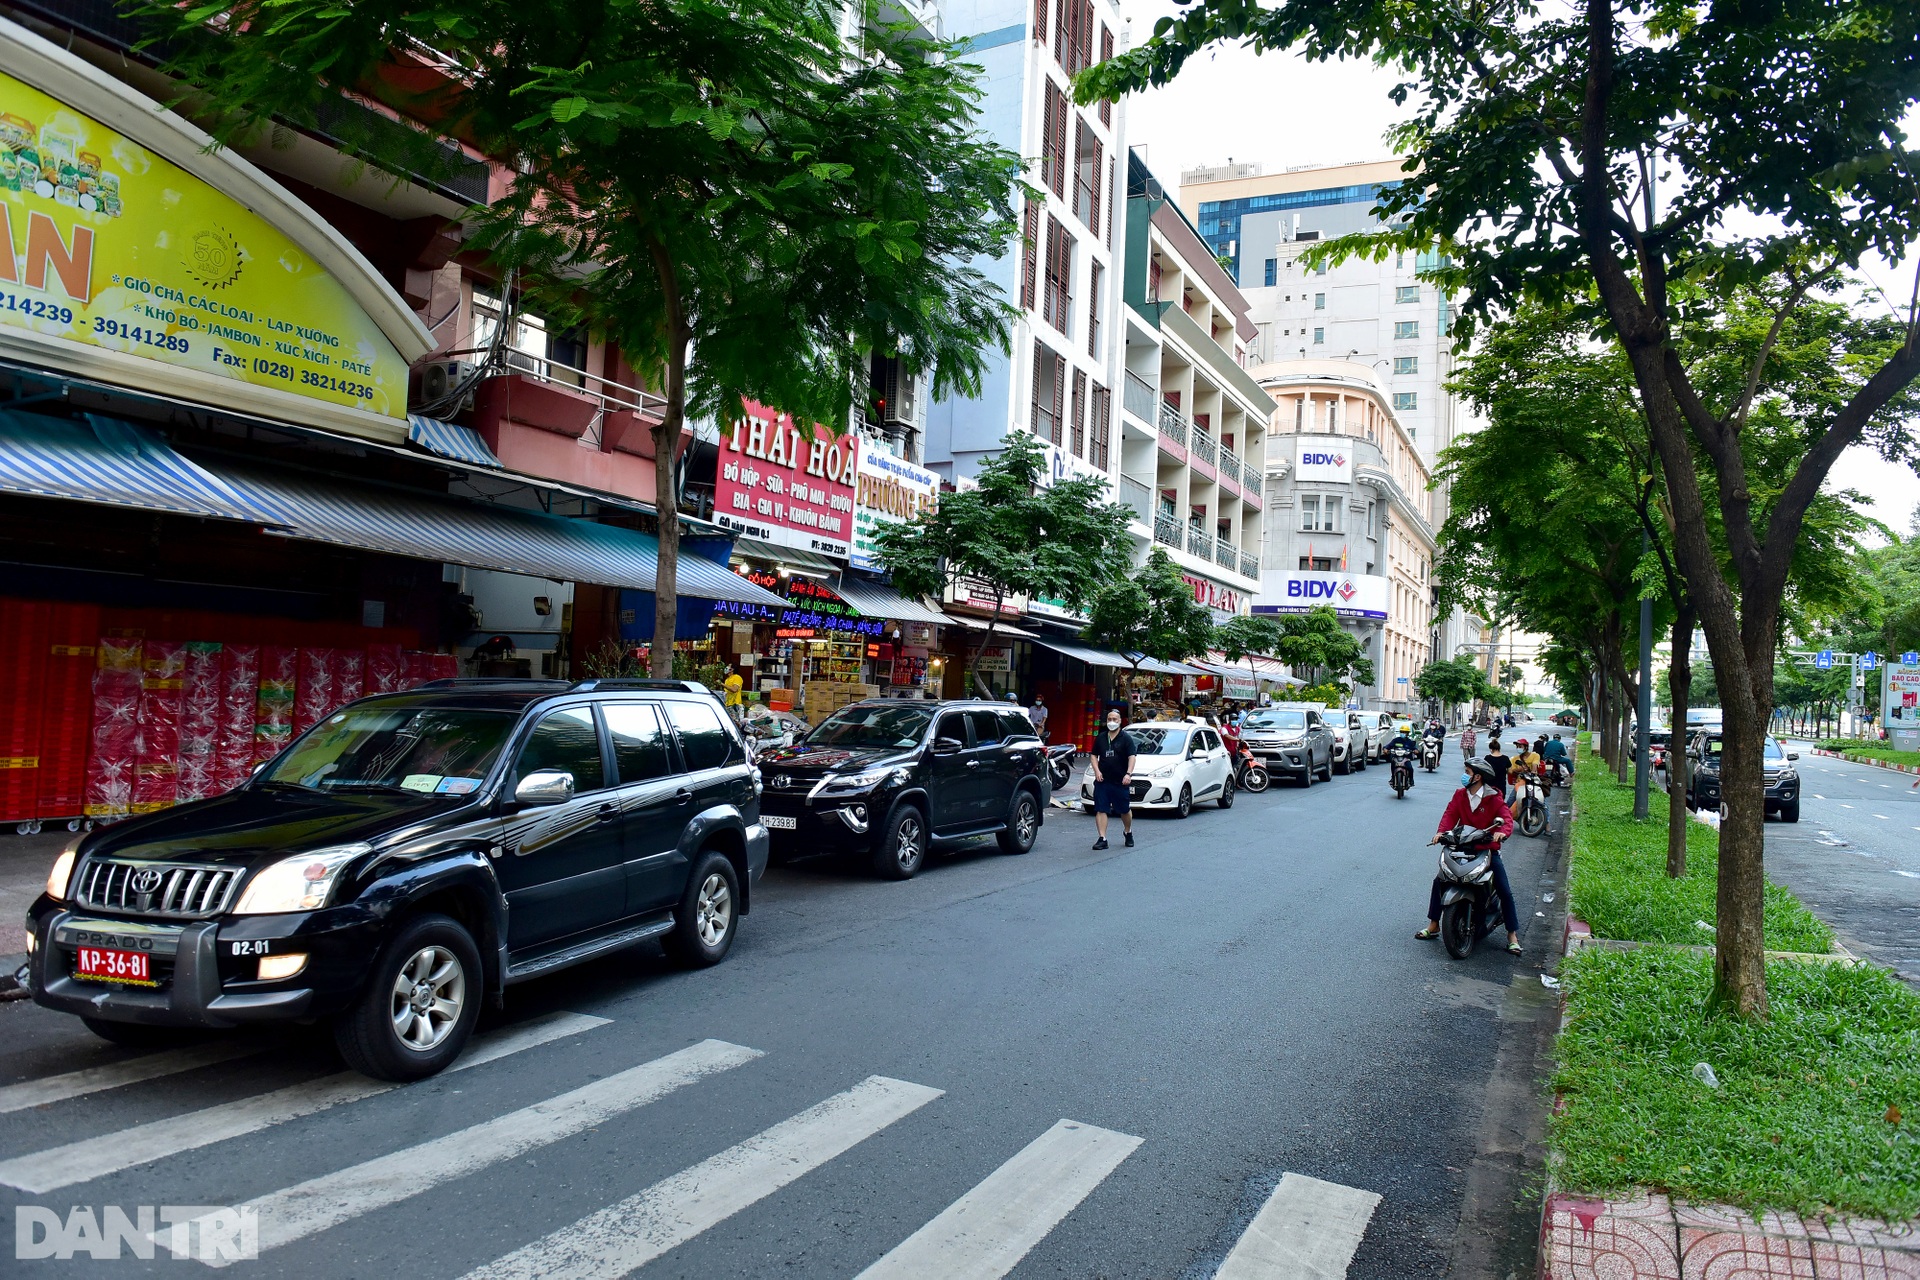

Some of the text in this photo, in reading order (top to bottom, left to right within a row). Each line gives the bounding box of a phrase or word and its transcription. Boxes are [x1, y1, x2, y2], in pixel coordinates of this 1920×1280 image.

[124, 276, 151, 294] GIÒ
[188, 294, 218, 313] CÁC
[93, 316, 189, 354] 39141289
[207, 322, 261, 347] JAMBON
[274, 341, 300, 357] XÚC
[302, 348, 330, 365] XÍCH
[213, 347, 374, 400] Fax: (028) 38214236
[729, 412, 856, 488] THÁI HOÀ
[1302, 453, 1334, 465] BIDV
[723, 460, 852, 514] ĐỒ HỘP SỮA PHÔ MAI RƯỢU
[733, 491, 841, 533] BIA GIA VỊ KHUÔN BÁNH
[760, 575, 776, 587] HỘP
[1288, 580, 1337, 598] BIDV
[1208, 583, 1240, 614] LAN
[1892, 674, 1904, 682] BAO
[760, 816, 795, 829] 1H-239.83
[76, 932, 153, 950] PRADO
[232, 940, 269, 956] 02-01
[81, 950, 147, 977] KP-36-81
